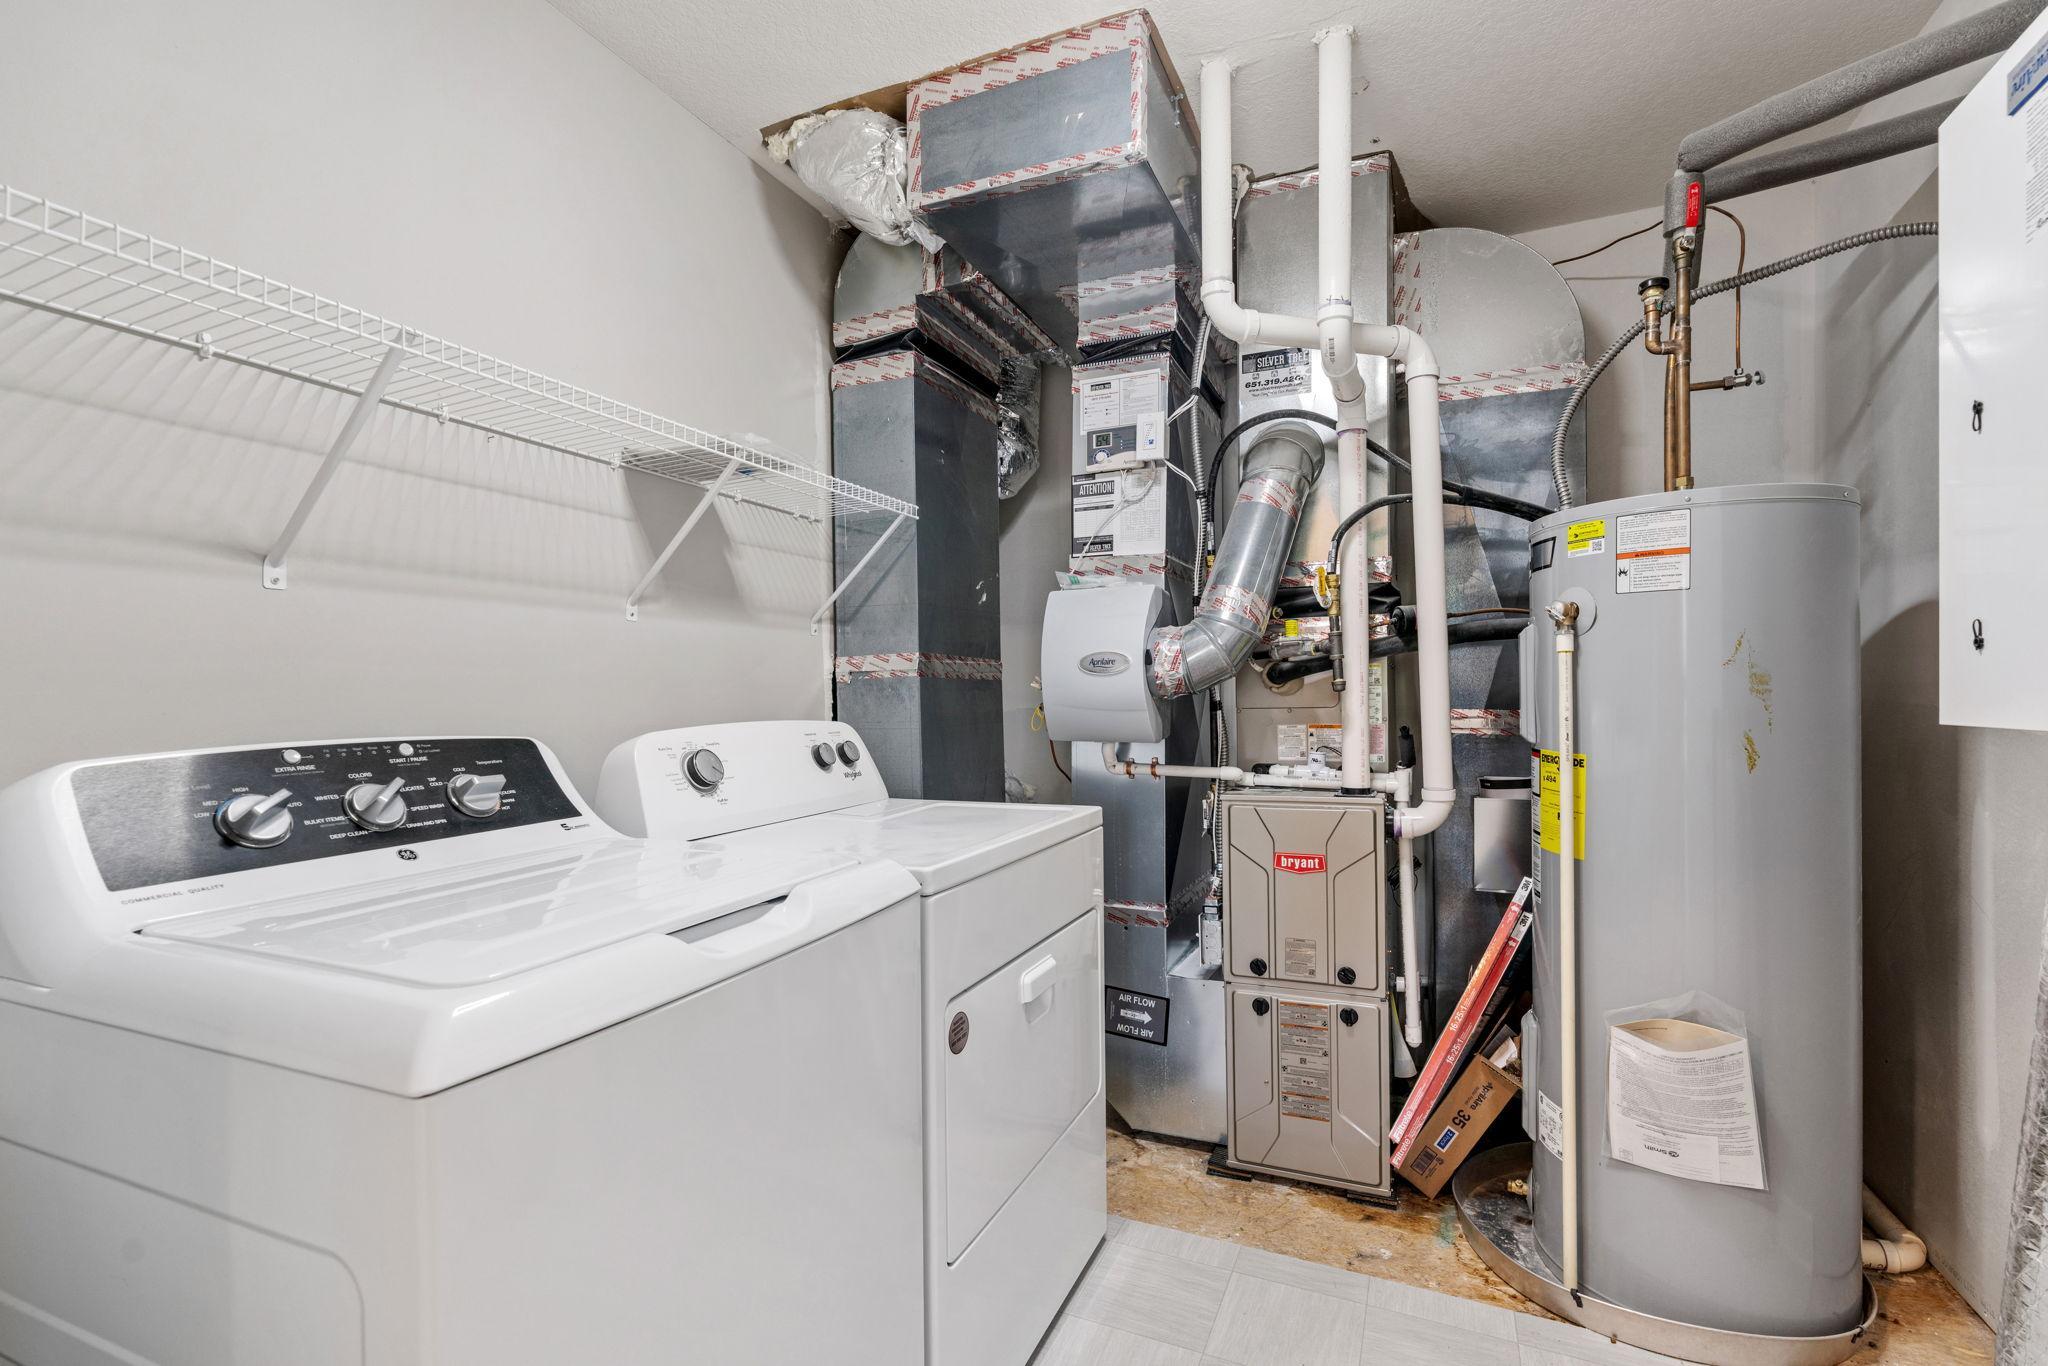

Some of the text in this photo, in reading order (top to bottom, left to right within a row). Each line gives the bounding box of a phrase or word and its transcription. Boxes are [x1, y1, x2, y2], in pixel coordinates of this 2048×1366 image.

[1257, 354, 1285, 368] SILVER
[1079, 481, 1114, 496] ATTENTION!
[348, 771, 373, 779] COLORS
[304, 818, 325, 826] BULKY
[325, 815, 346, 823] ITEMS
[329, 832, 347, 840] DEEP
[1281, 856, 1320, 869] bryant
[1521, 880, 1532, 892] 3M
[120, 884, 224, 905] COMMERCIAL QUALITY
[1519, 914, 1530, 927] 3M
[1119, 993, 1156, 1008] AIR FLOW
[1116, 1023, 1154, 1038] AIR FLOW
[1393, 1109, 1413, 1144] Filtrete
[1452, 1109, 1471, 1130] 35
[1392, 1137, 1411, 1165] Filtrete
[1644, 1144, 1668, 1155] Smith
